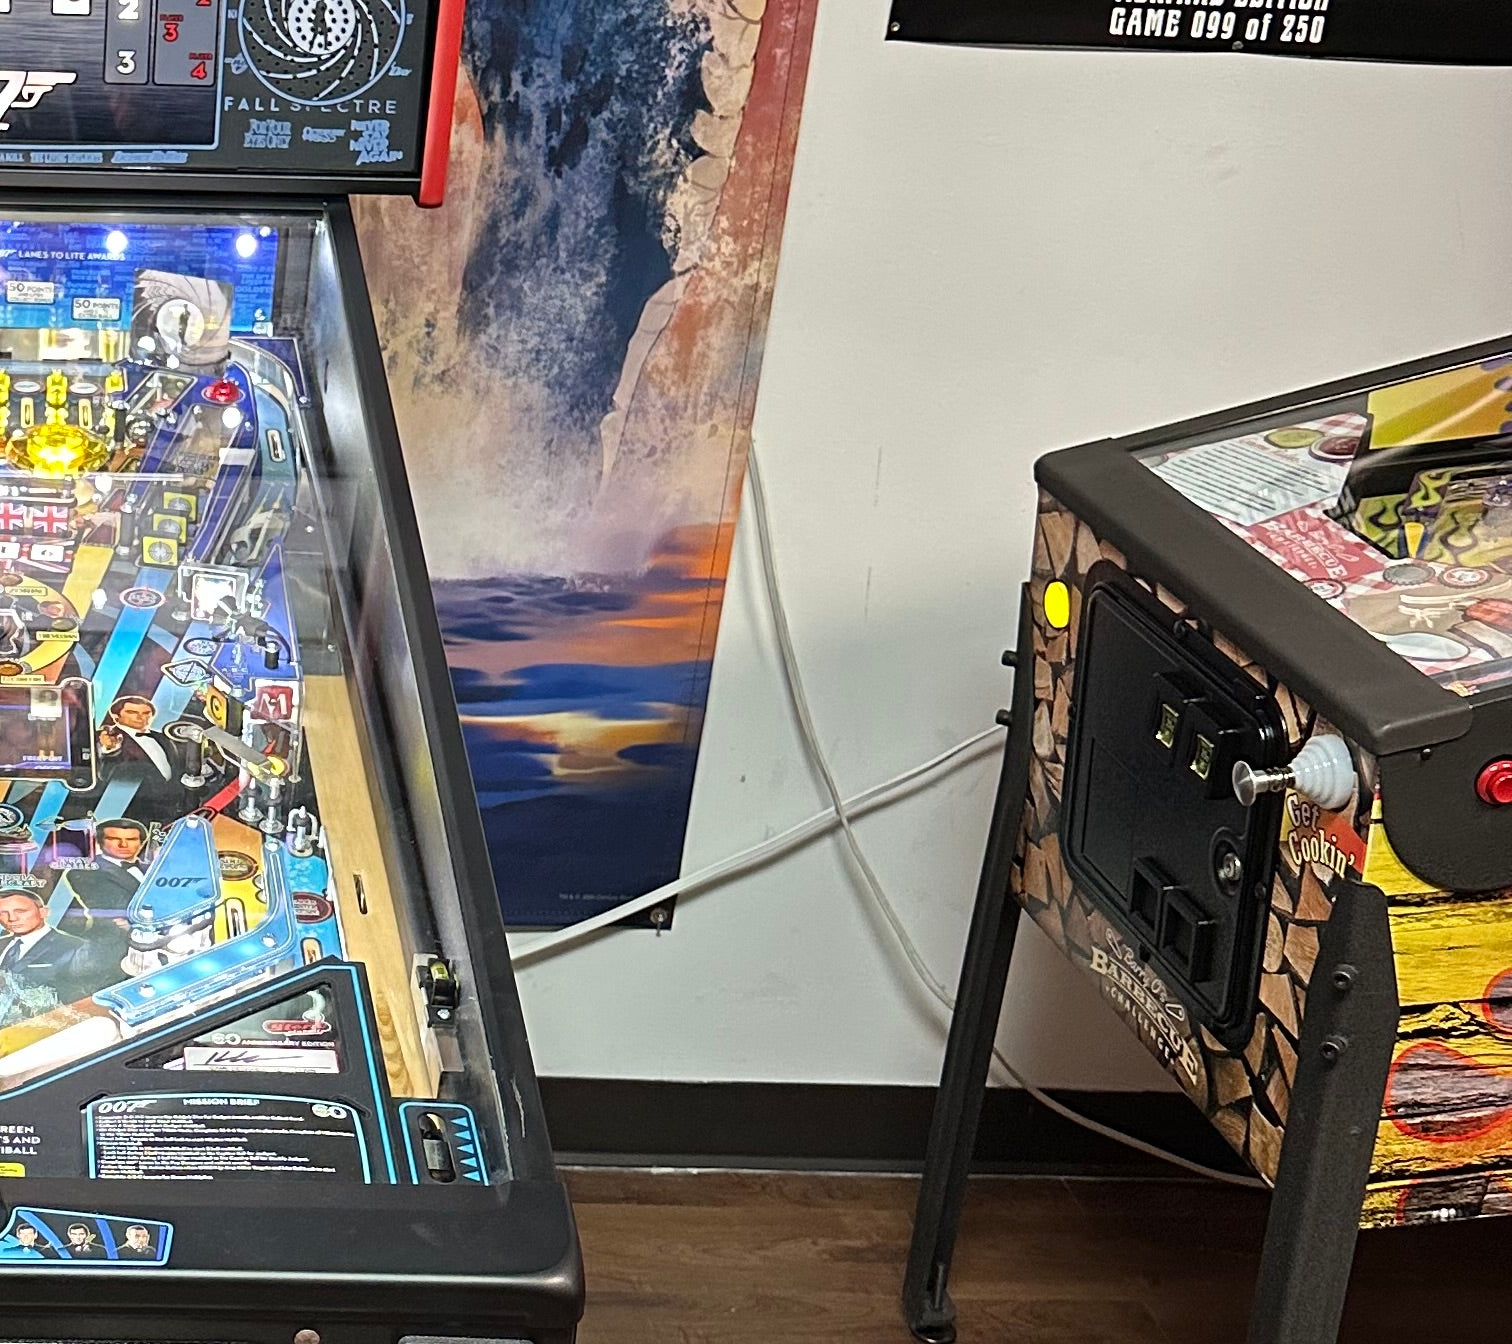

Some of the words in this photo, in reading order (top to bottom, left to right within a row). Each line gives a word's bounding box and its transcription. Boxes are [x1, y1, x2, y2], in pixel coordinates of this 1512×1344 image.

[163, 23, 179, 42] 3
[1109, 7, 1182, 37] GAME
[1190, 10, 1236, 40] 099
[1245, 12, 1273, 41] of
[1280, 14, 1325, 43] 250
[116, 50, 136, 75] 3
[190, 61, 207, 80] 4
[224, 96, 280, 112] FALL
[9, 283, 25, 292] 50
[75, 300, 91, 309] 50
[1287, 793, 1320, 832] Get
[1288, 829, 1355, 879] Cookin'
[156, 877, 207, 888] 007
[1090, 946, 1199, 1086] BARBECUE
[98, 1100, 157, 1114] 007
[11, 1136, 41, 1144] AND
